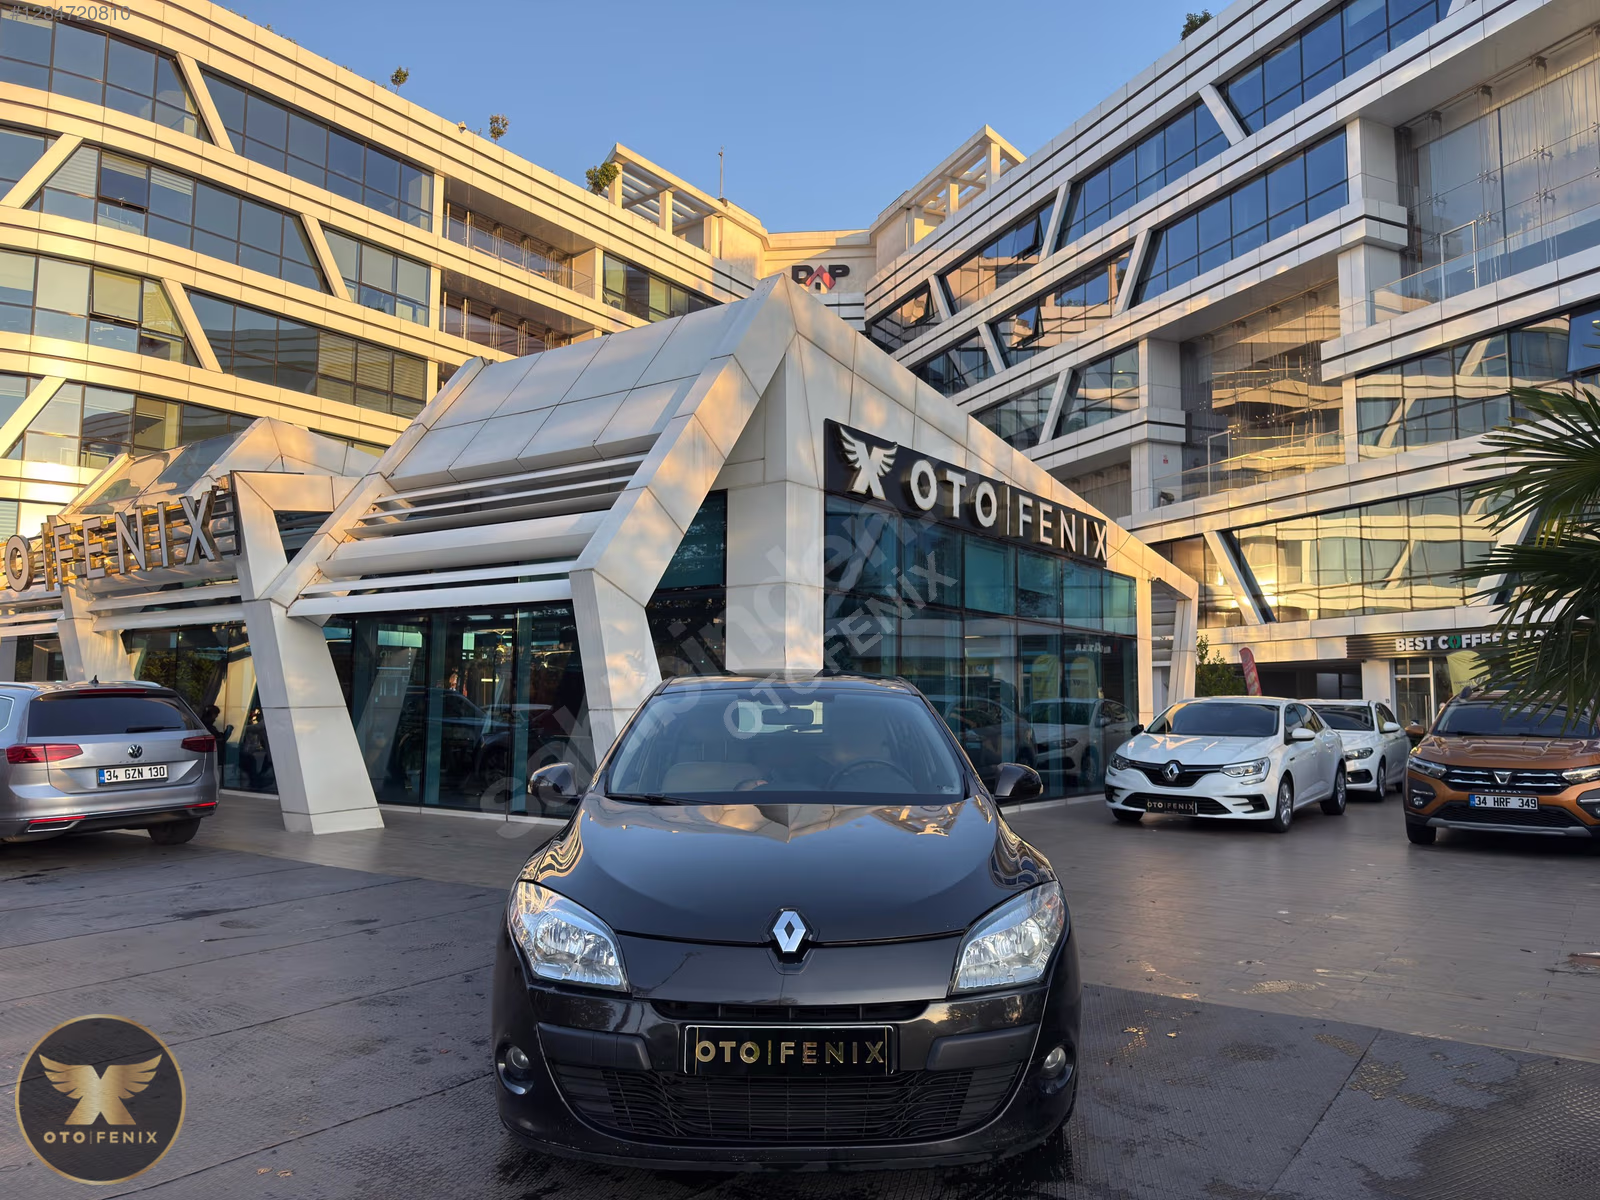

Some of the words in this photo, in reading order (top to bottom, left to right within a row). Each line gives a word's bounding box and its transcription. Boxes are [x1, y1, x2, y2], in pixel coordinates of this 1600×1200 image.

[1395, 636, 1434, 652] BEST
[105, 769, 119, 781] 34
[124, 768, 144, 780] GZN
[148, 766, 165, 778] 130
[1475, 795, 1487, 806] 34
[1493, 796, 1511, 807] HRF
[1518, 797, 1537, 809] 349
[695, 1040, 761, 1064] OTO
[780, 1041, 884, 1065] FENIX
